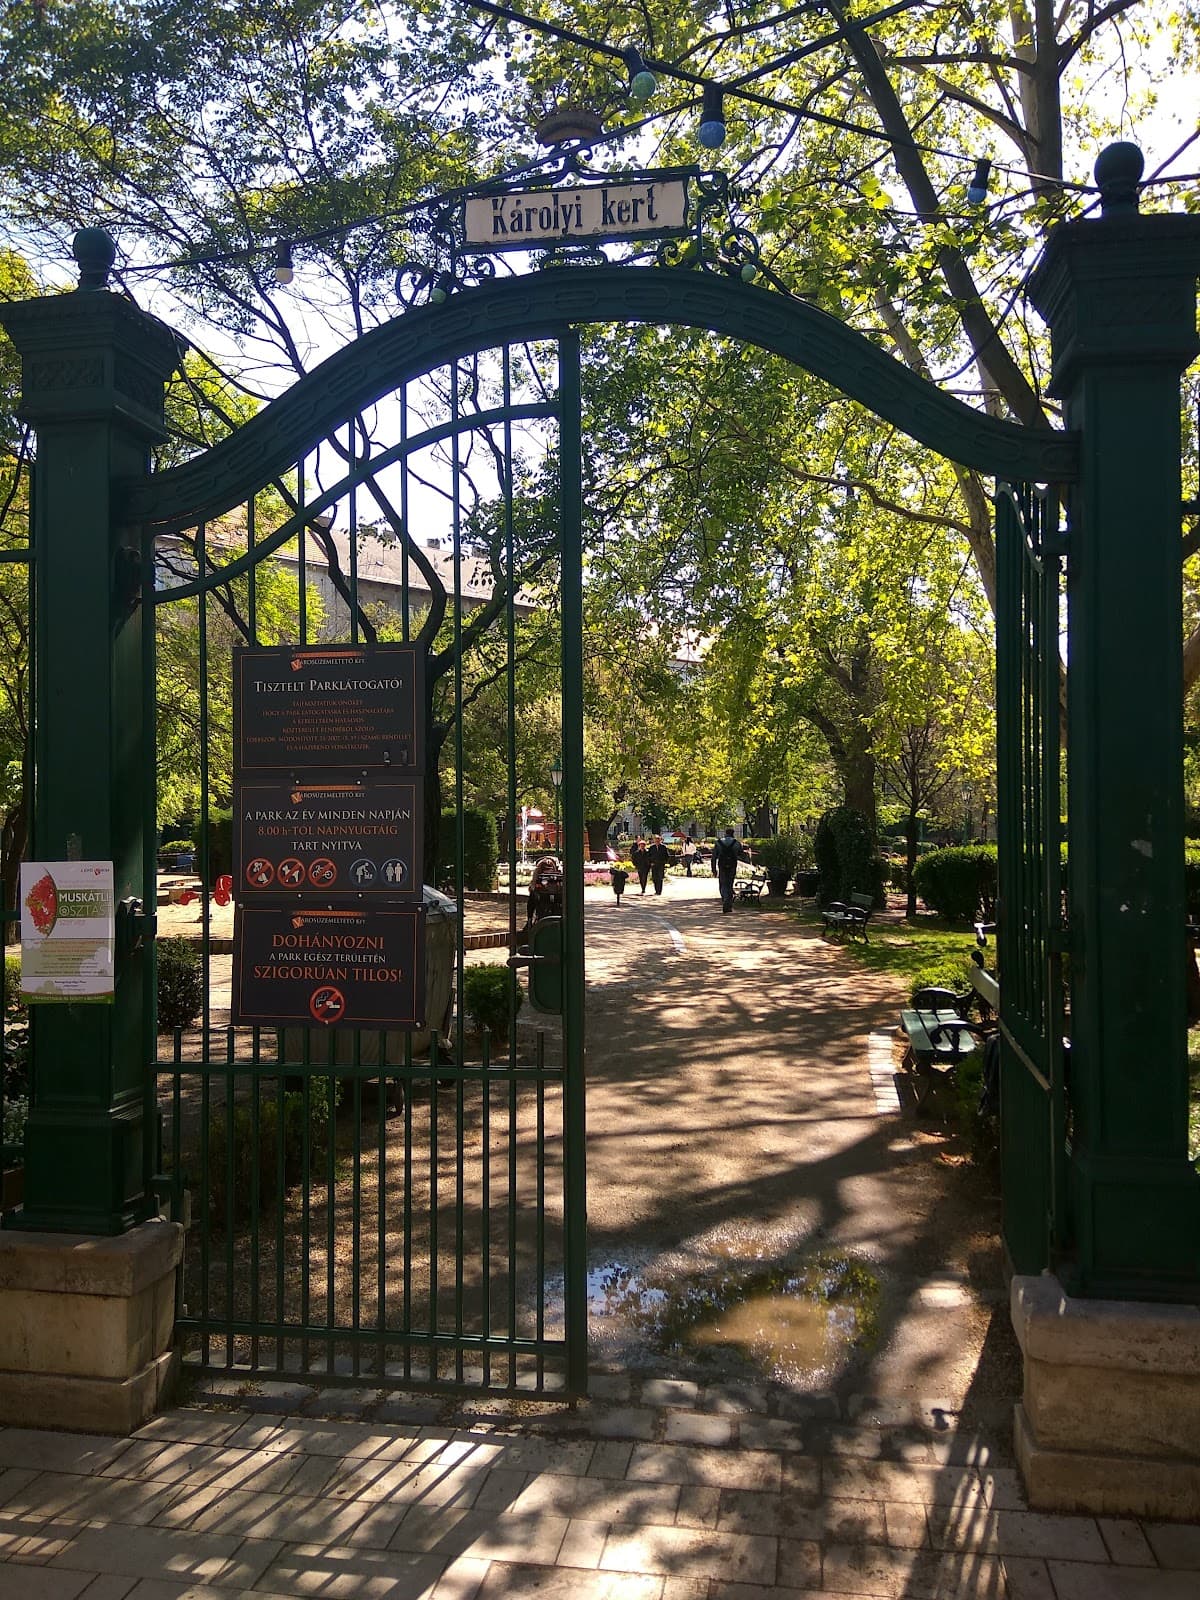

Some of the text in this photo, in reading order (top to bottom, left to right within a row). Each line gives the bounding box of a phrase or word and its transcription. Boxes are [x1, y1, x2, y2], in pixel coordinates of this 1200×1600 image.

[492, 184, 657, 234] Károlyi kert
[254, 677, 402, 692] TISZTELT PARKLÁTOGATÓ!
[246, 808, 410, 821] A PARK AZ ÉV MINDEN NAPJÁN
[317, 824, 398, 835] NAPNYUGTÁIG
[292, 841, 362, 850] TART NYITVA
[273, 932, 384, 949] DOHÁNYOZNI
[270, 952, 276, 960] A
[278, 953, 301, 961] PARK
[304, 951, 332, 962] EGÉSZ
[254, 964, 402, 982] SZIGORÚAN TILOS!
